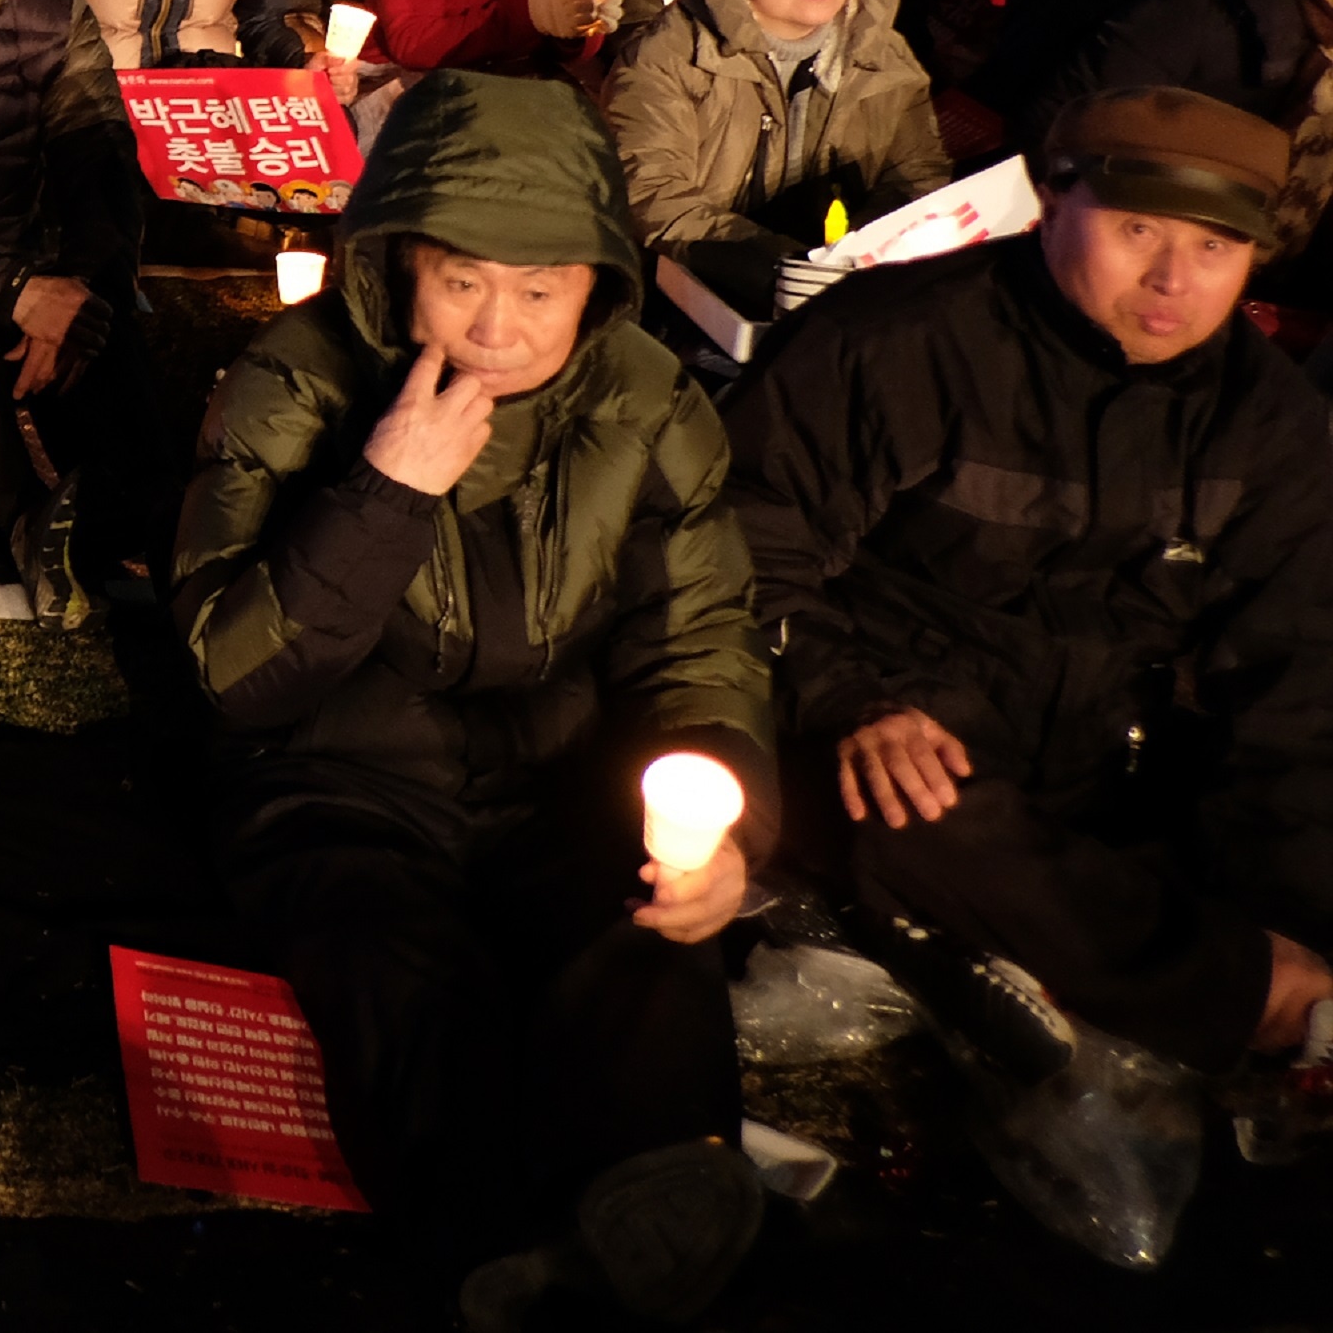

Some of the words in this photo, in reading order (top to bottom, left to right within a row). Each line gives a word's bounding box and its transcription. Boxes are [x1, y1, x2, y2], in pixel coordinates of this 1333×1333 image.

[129, 97, 252, 134] 박근혜
[248, 96, 329, 133] 탄핵
[166, 136, 246, 176] 촛불
[249, 136, 331, 177] 승리
